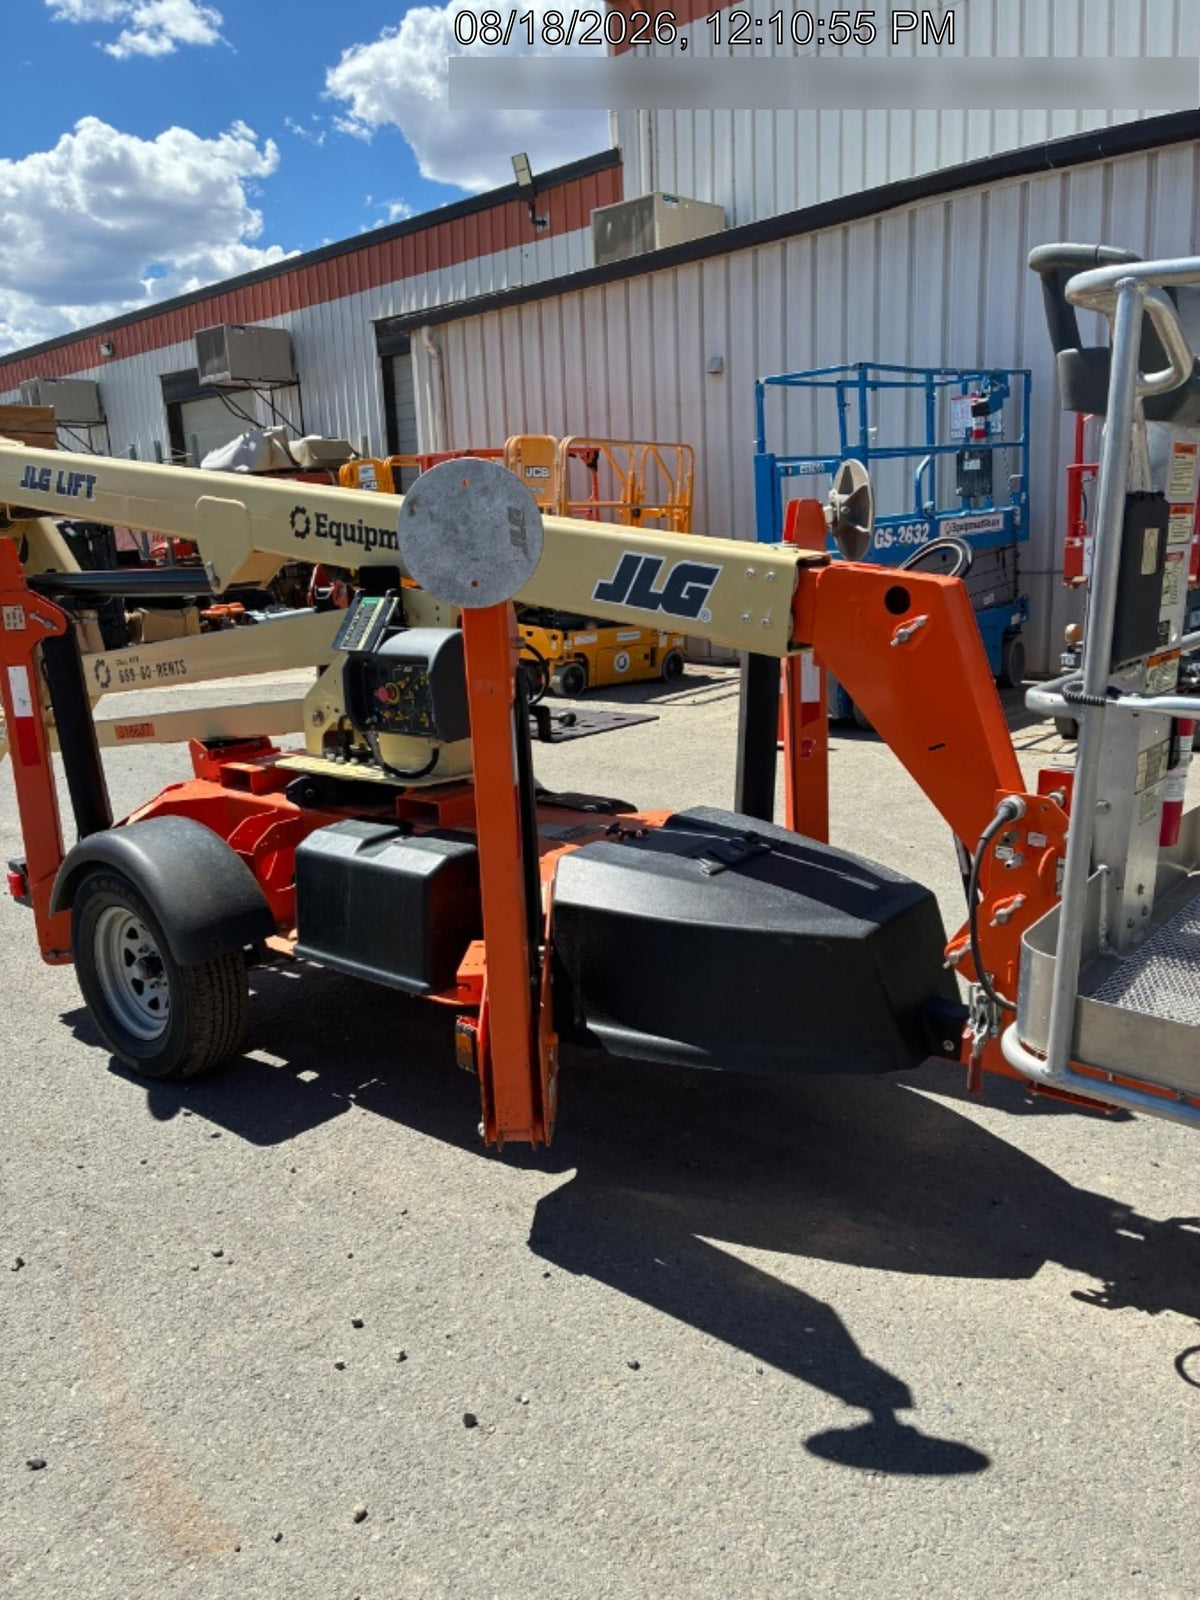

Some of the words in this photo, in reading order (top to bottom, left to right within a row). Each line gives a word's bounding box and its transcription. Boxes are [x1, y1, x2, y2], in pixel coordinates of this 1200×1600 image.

[20, 464, 53, 493] JLG
[55, 469, 97, 501] LIFT
[525, 466, 549, 478] JCB
[314, 511, 400, 552] Equipm
[590, 549, 723, 620] JLG
